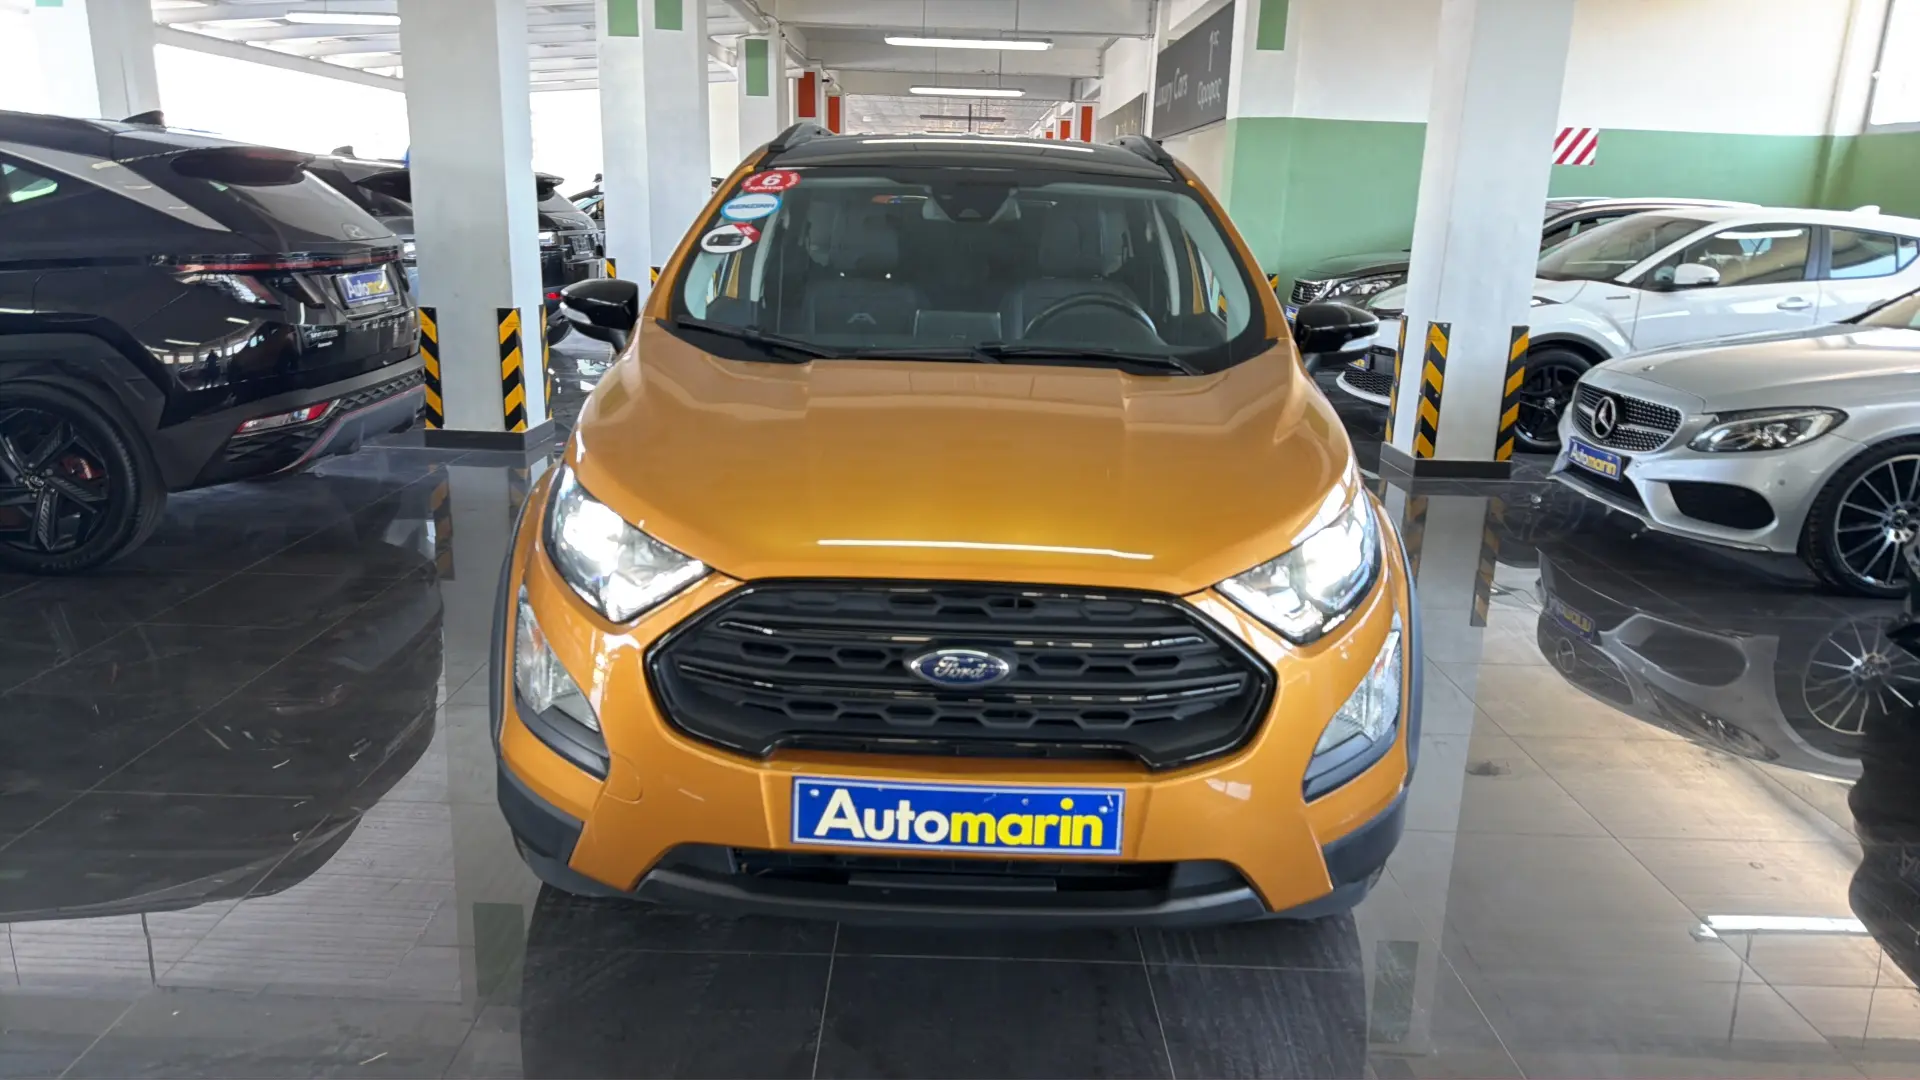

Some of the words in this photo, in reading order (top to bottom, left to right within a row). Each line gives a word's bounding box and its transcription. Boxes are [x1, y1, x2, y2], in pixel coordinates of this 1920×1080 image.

[1174, 67, 1189, 100] Cars
[762, 172, 784, 187] 6
[346, 276, 390, 298] Autom
[1570, 442, 1617, 475] Automarin
[933, 656, 987, 678] Ford
[814, 788, 1103, 846] Automarin
